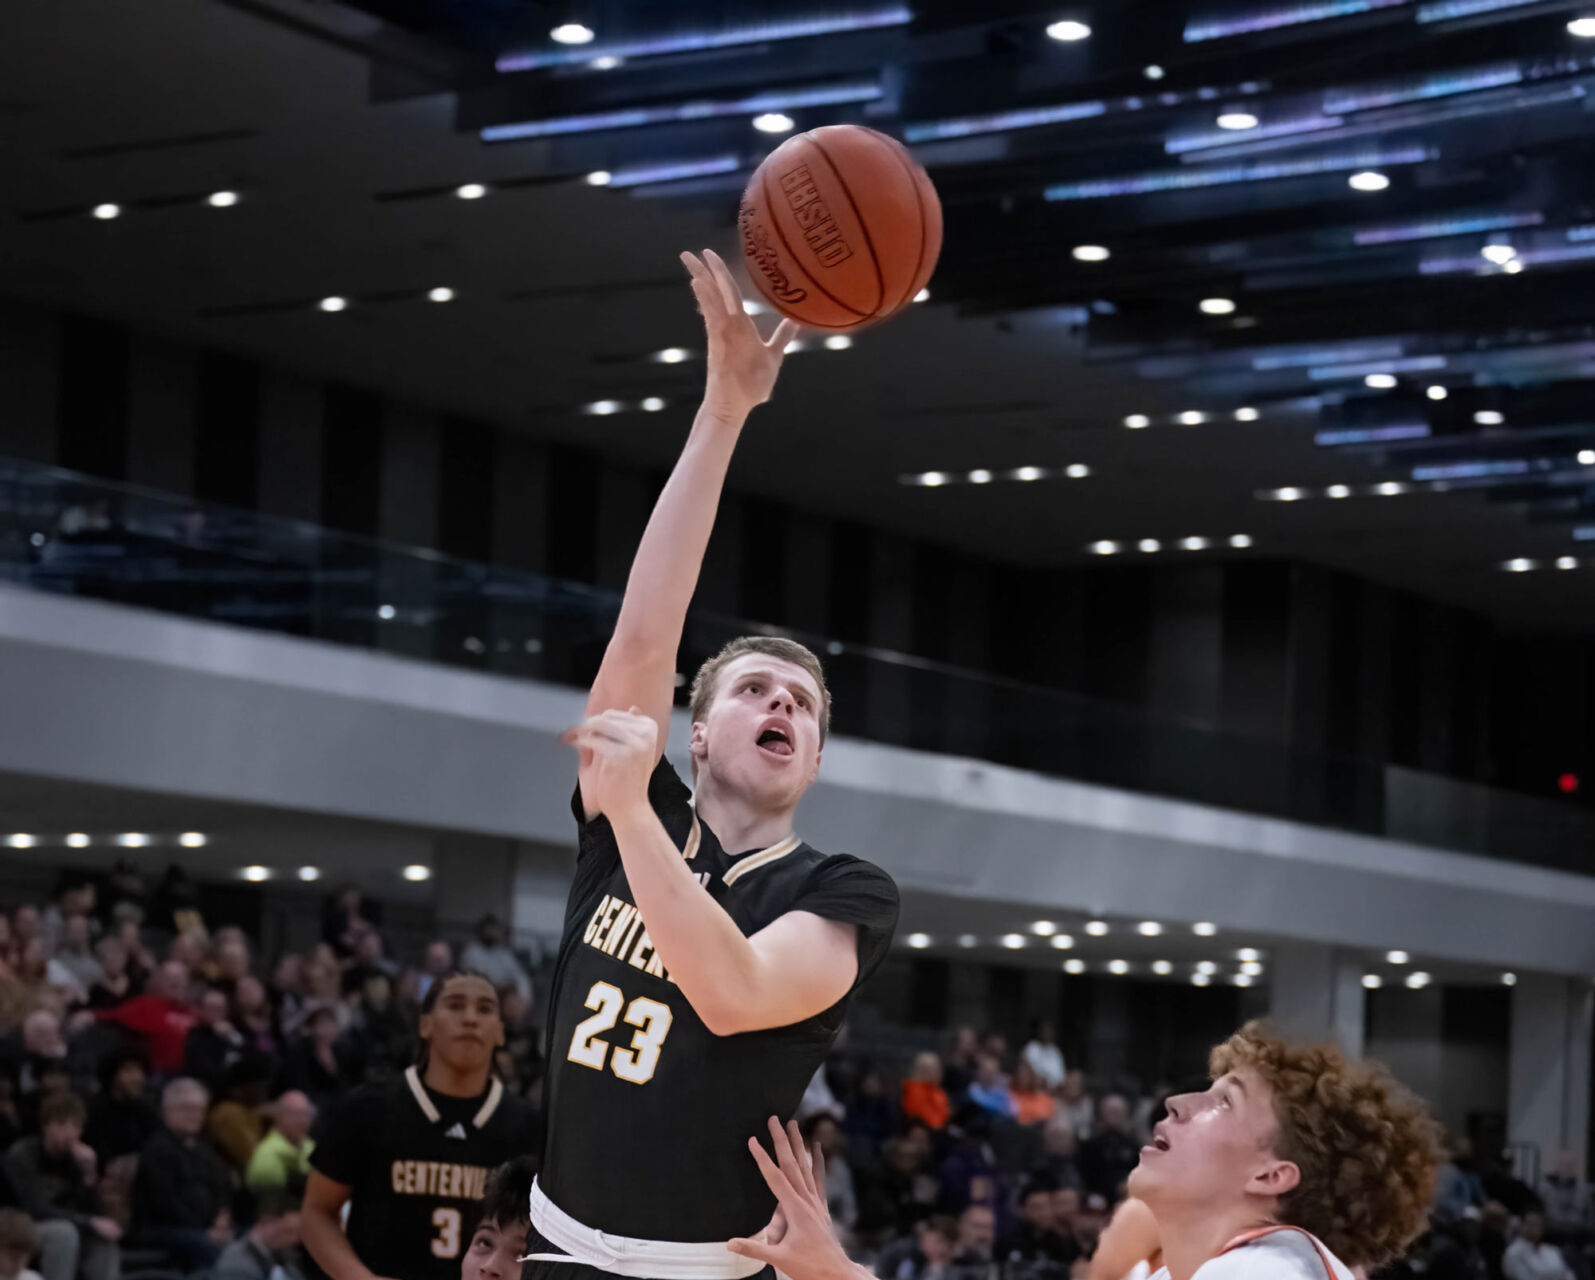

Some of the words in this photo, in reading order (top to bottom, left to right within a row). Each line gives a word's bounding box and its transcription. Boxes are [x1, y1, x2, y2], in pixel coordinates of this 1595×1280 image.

[780, 165, 853, 268] OHSAA
[567, 980, 674, 1085] 23
[430, 1206, 463, 1259] 3
